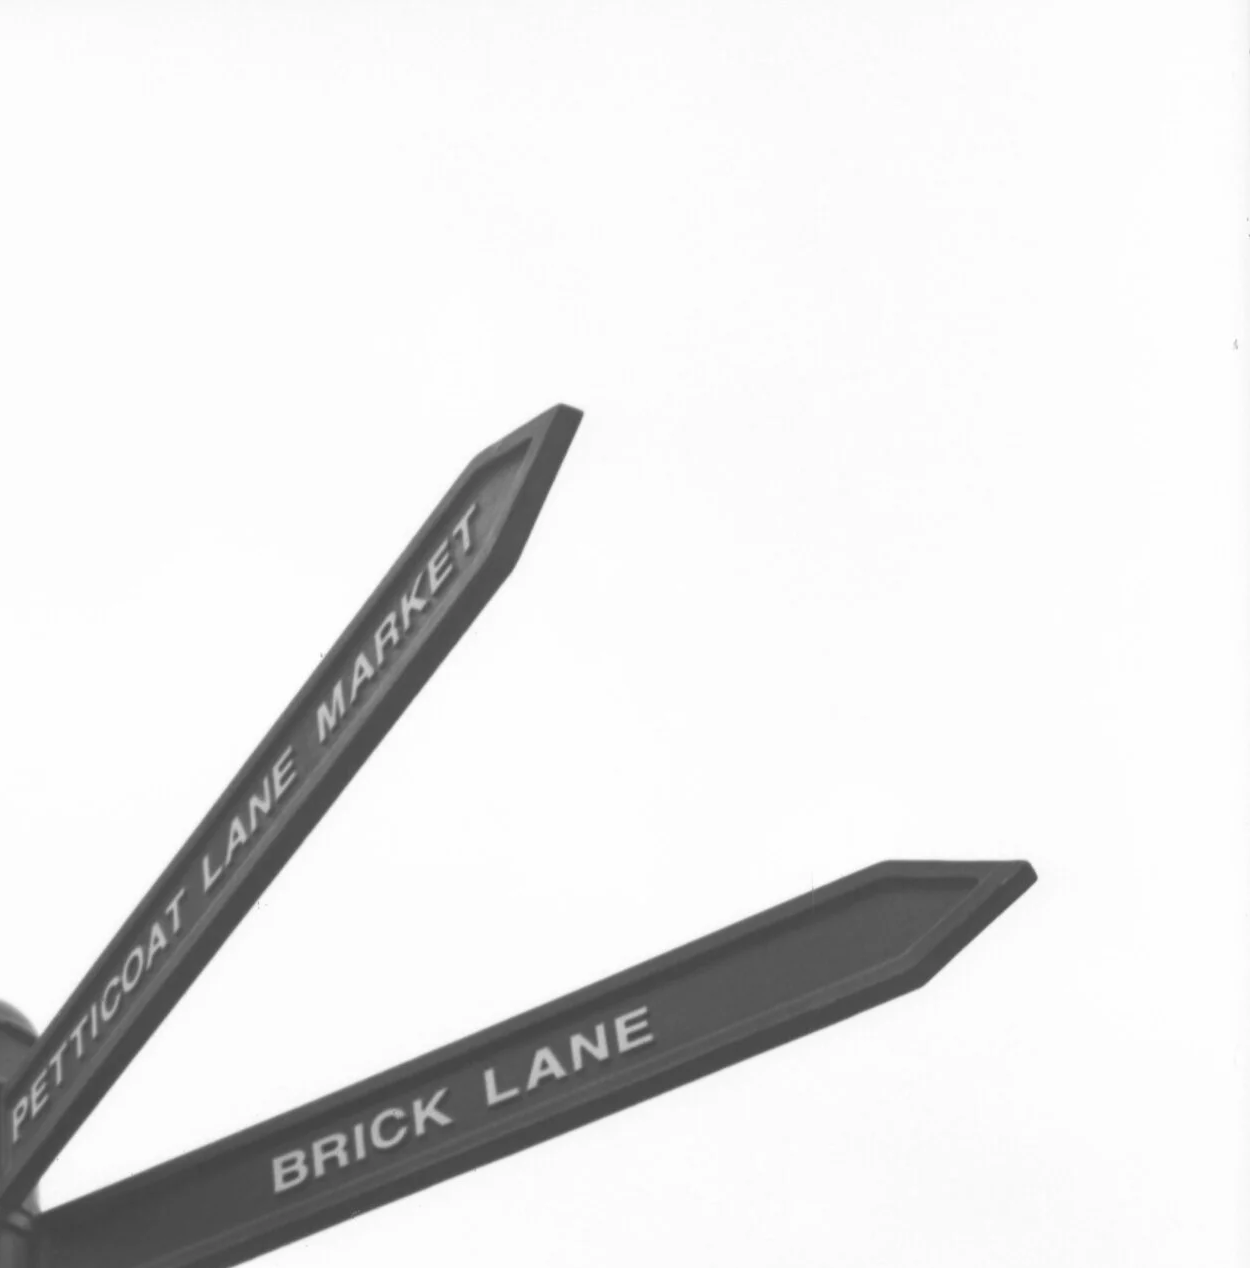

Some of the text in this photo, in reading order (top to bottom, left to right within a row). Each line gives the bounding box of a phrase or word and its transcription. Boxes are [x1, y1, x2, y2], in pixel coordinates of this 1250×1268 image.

[11, 504, 479, 1143] PETTICOAT LANE MARKET
[272, 1006, 654, 1194] BRICK LANE
